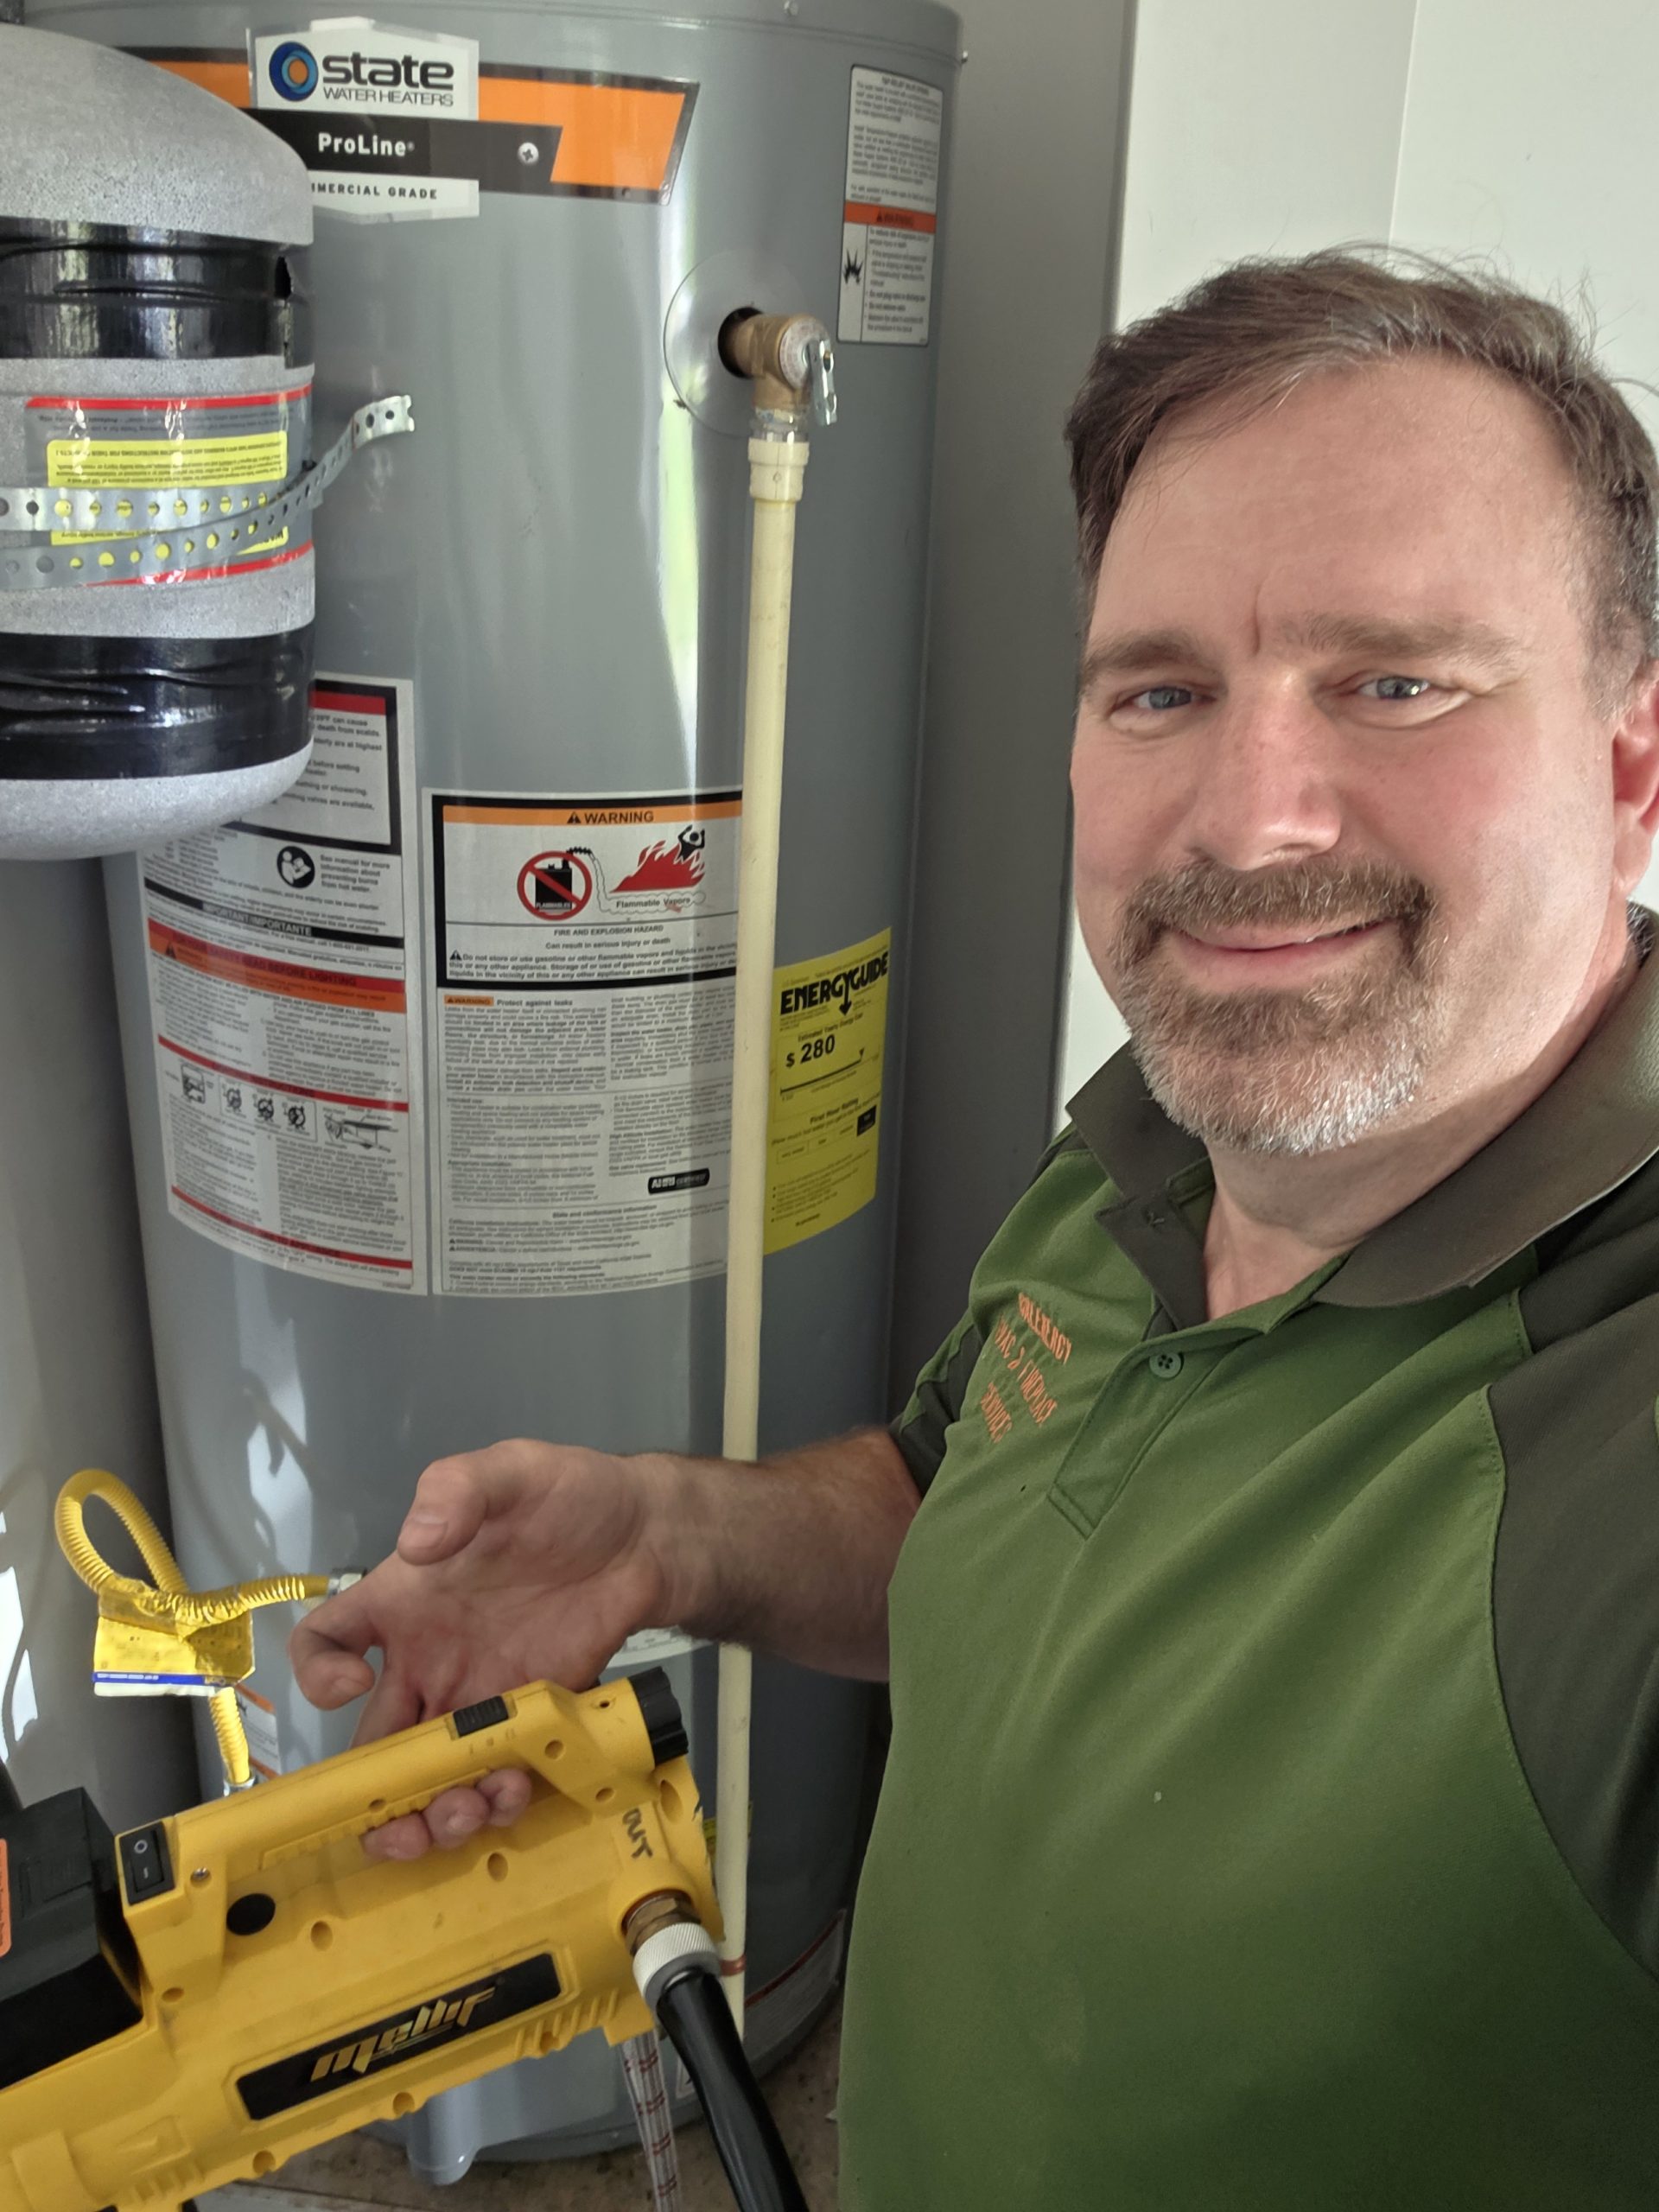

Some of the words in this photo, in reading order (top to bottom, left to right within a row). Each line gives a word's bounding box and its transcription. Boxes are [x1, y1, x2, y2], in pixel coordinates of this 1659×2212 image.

[322, 52, 454, 91] state
[323, 86, 377, 102] WATER
[379, 89, 454, 107] HEATERS
[388, 186, 437, 200] GRADE
[584, 810, 654, 824] WARNING
[616, 899, 661, 909] Flammable
[780, 951, 888, 1015] ENERGYGUIDE
[785, 1052, 795, 1070] $
[800, 1033, 836, 1065] 280
